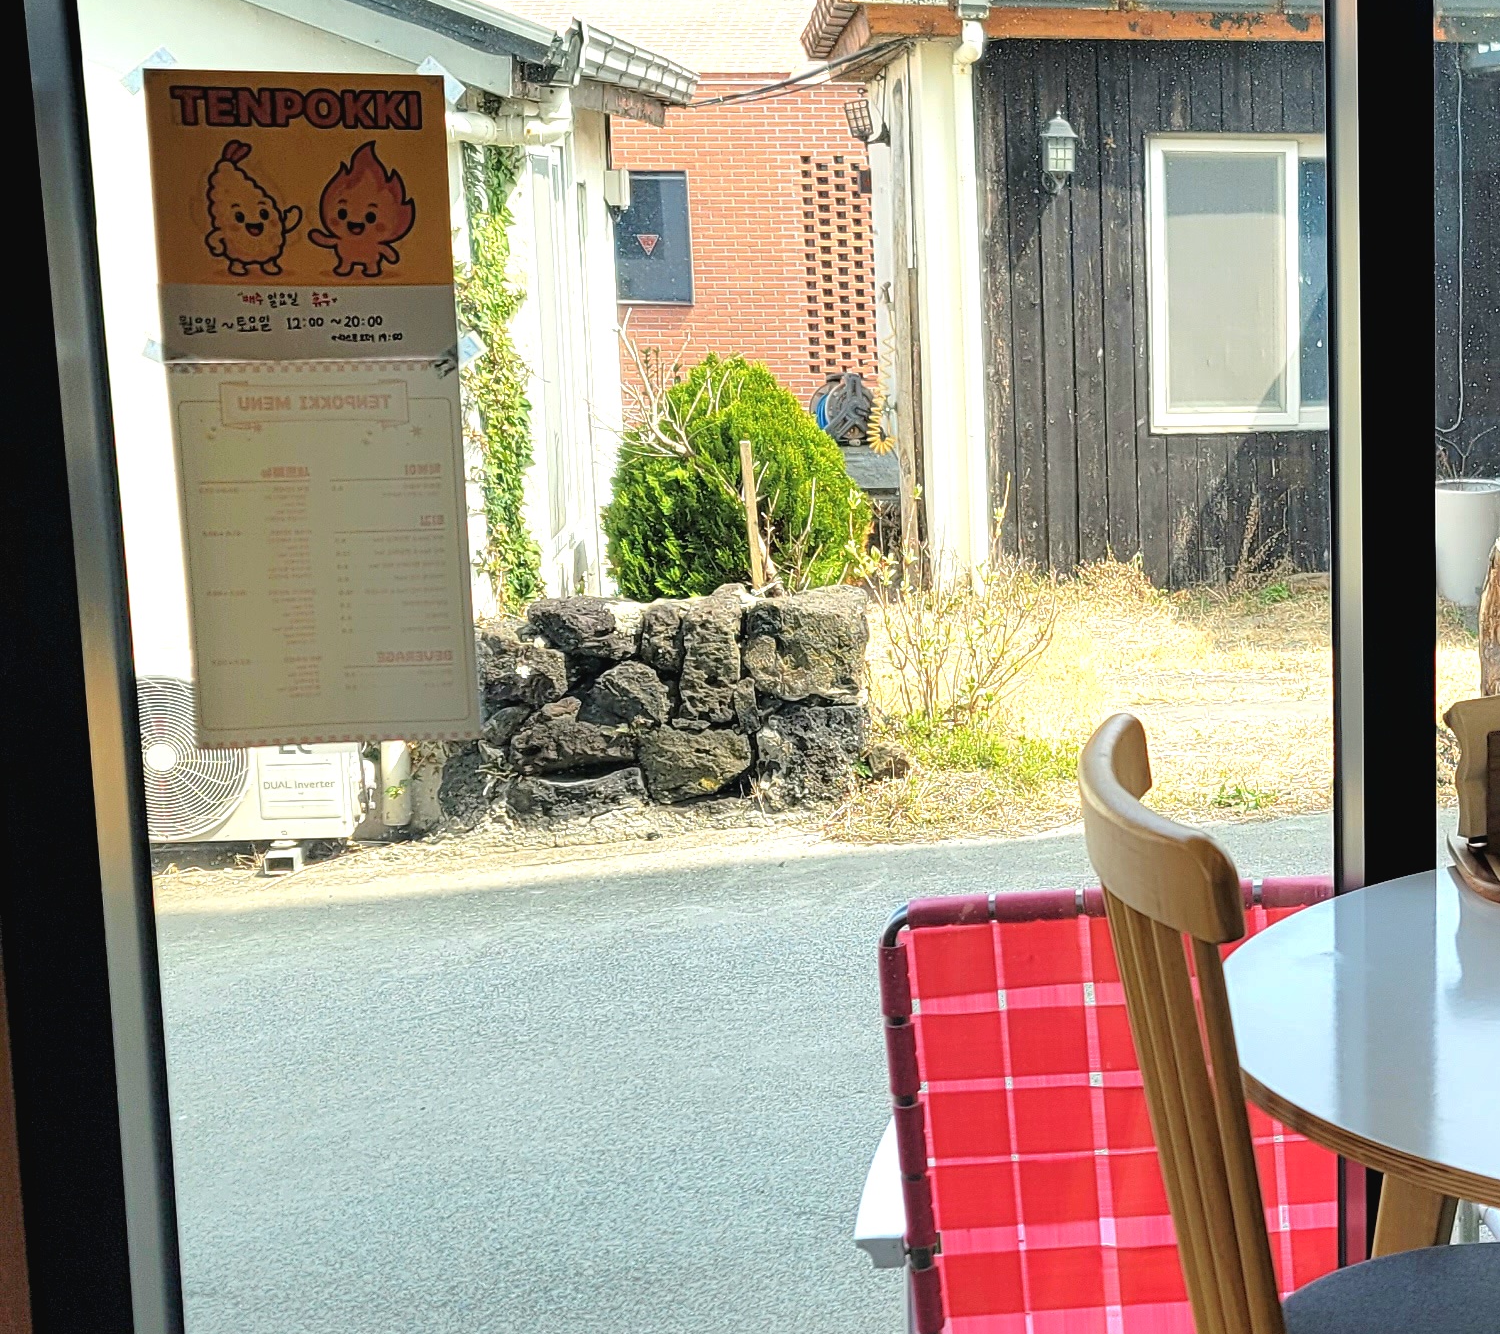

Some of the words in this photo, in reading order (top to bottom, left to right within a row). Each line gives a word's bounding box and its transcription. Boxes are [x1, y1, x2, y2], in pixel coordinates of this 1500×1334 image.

[169, 85, 423, 131] TENPOKKI
[267, 292, 300, 308] 일요일
[179, 315, 217, 335] 월요일
[286, 317, 324, 330] 12:00
[263, 780, 292, 790] DUAL
[294, 779, 336, 790] Inverter
